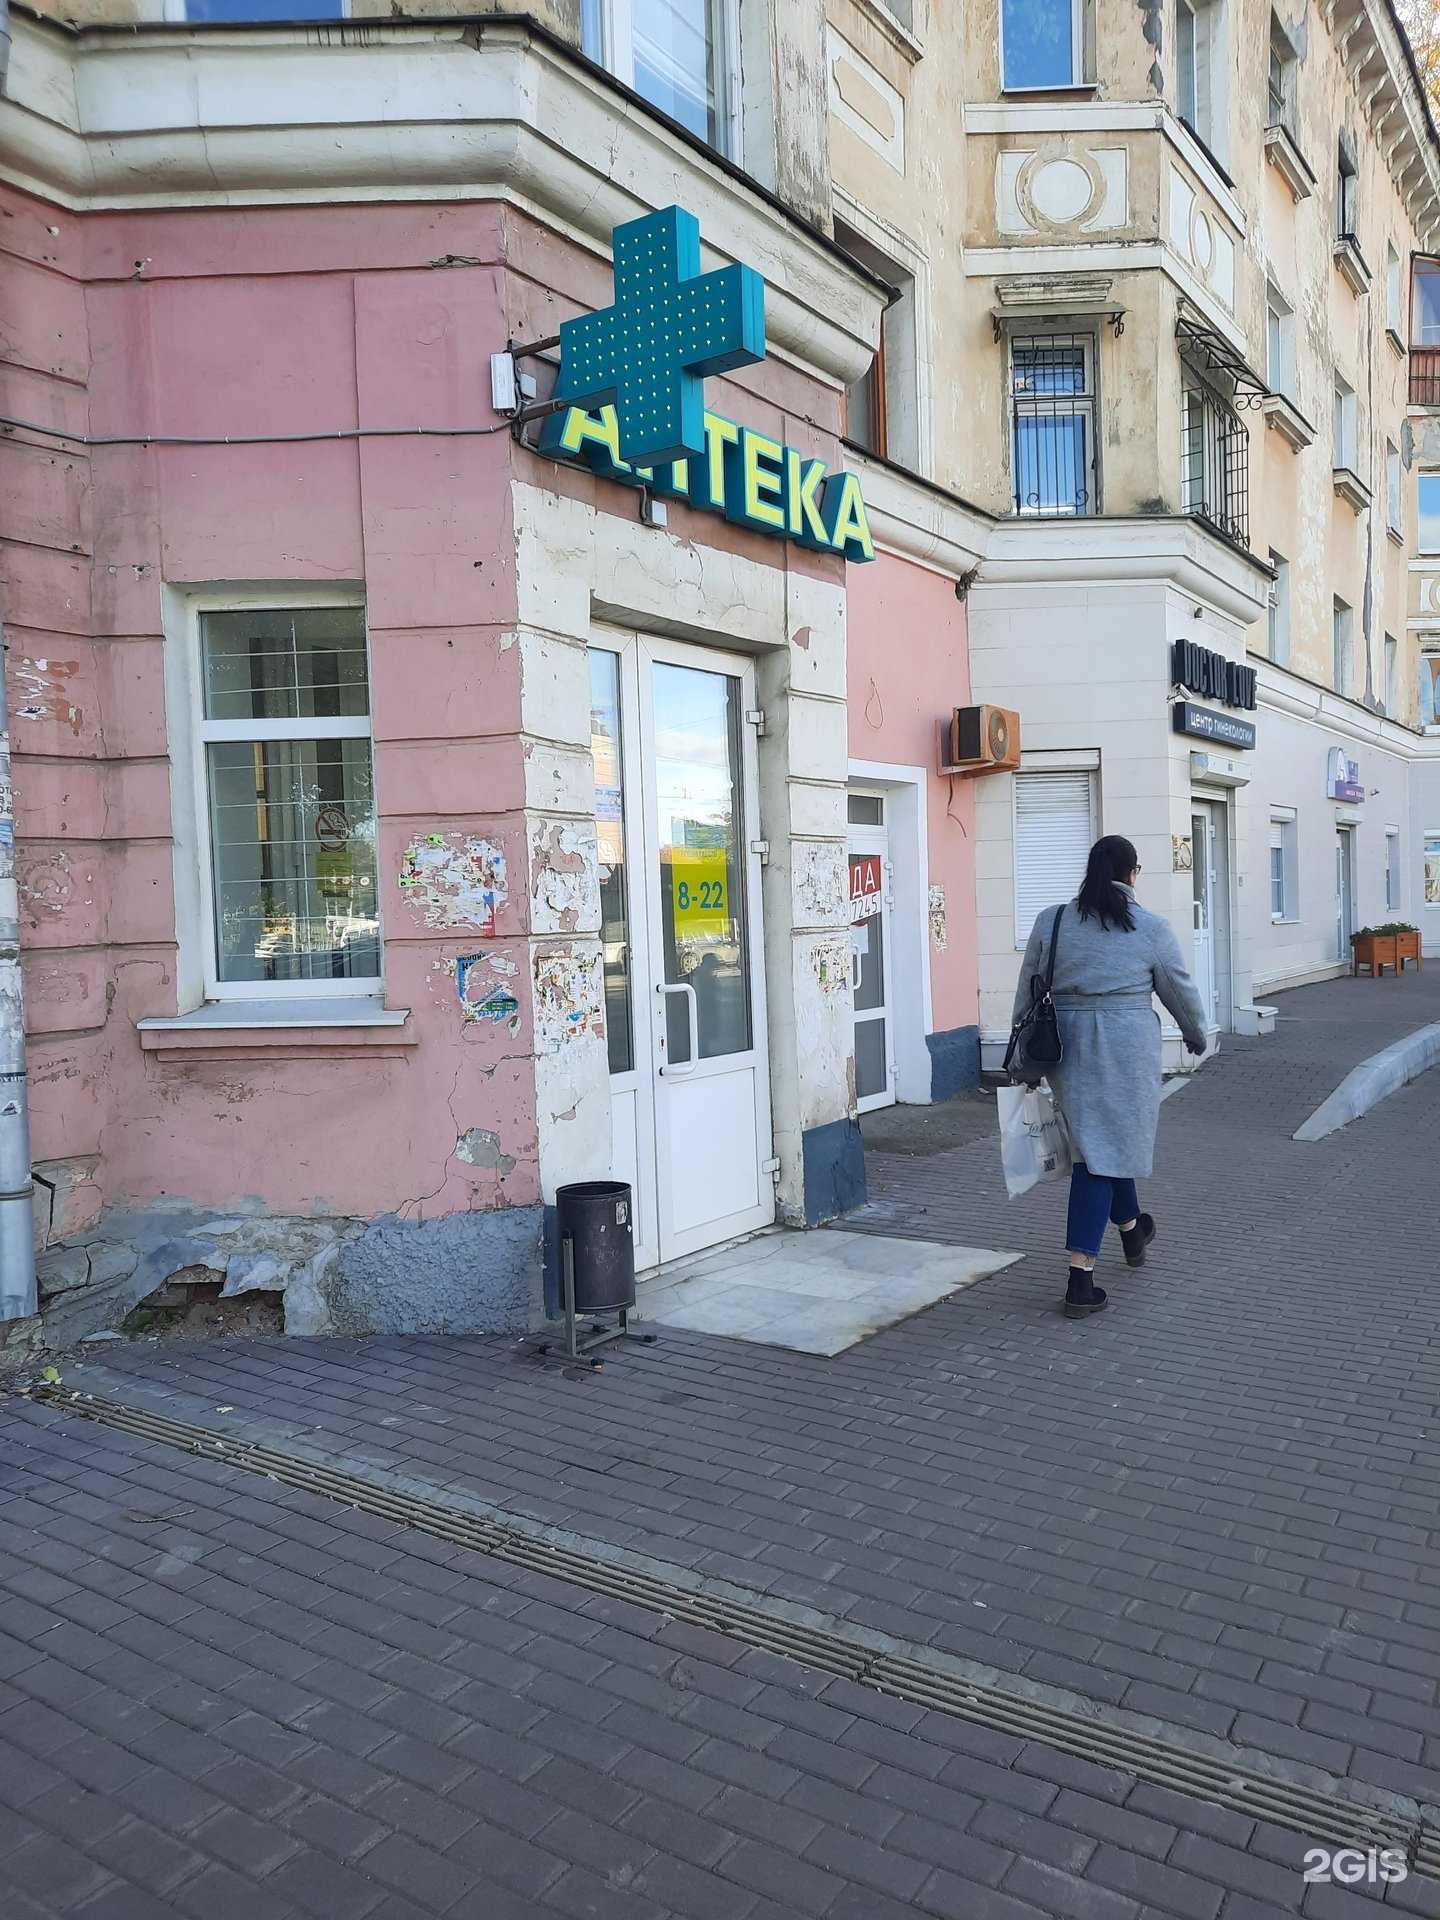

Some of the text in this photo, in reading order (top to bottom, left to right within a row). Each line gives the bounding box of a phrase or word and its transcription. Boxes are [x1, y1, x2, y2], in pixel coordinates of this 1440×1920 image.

[556, 404, 876, 562] АТЕКА
[1190, 711, 1213, 736] центр
[678, 881, 724, 910] 8-22
